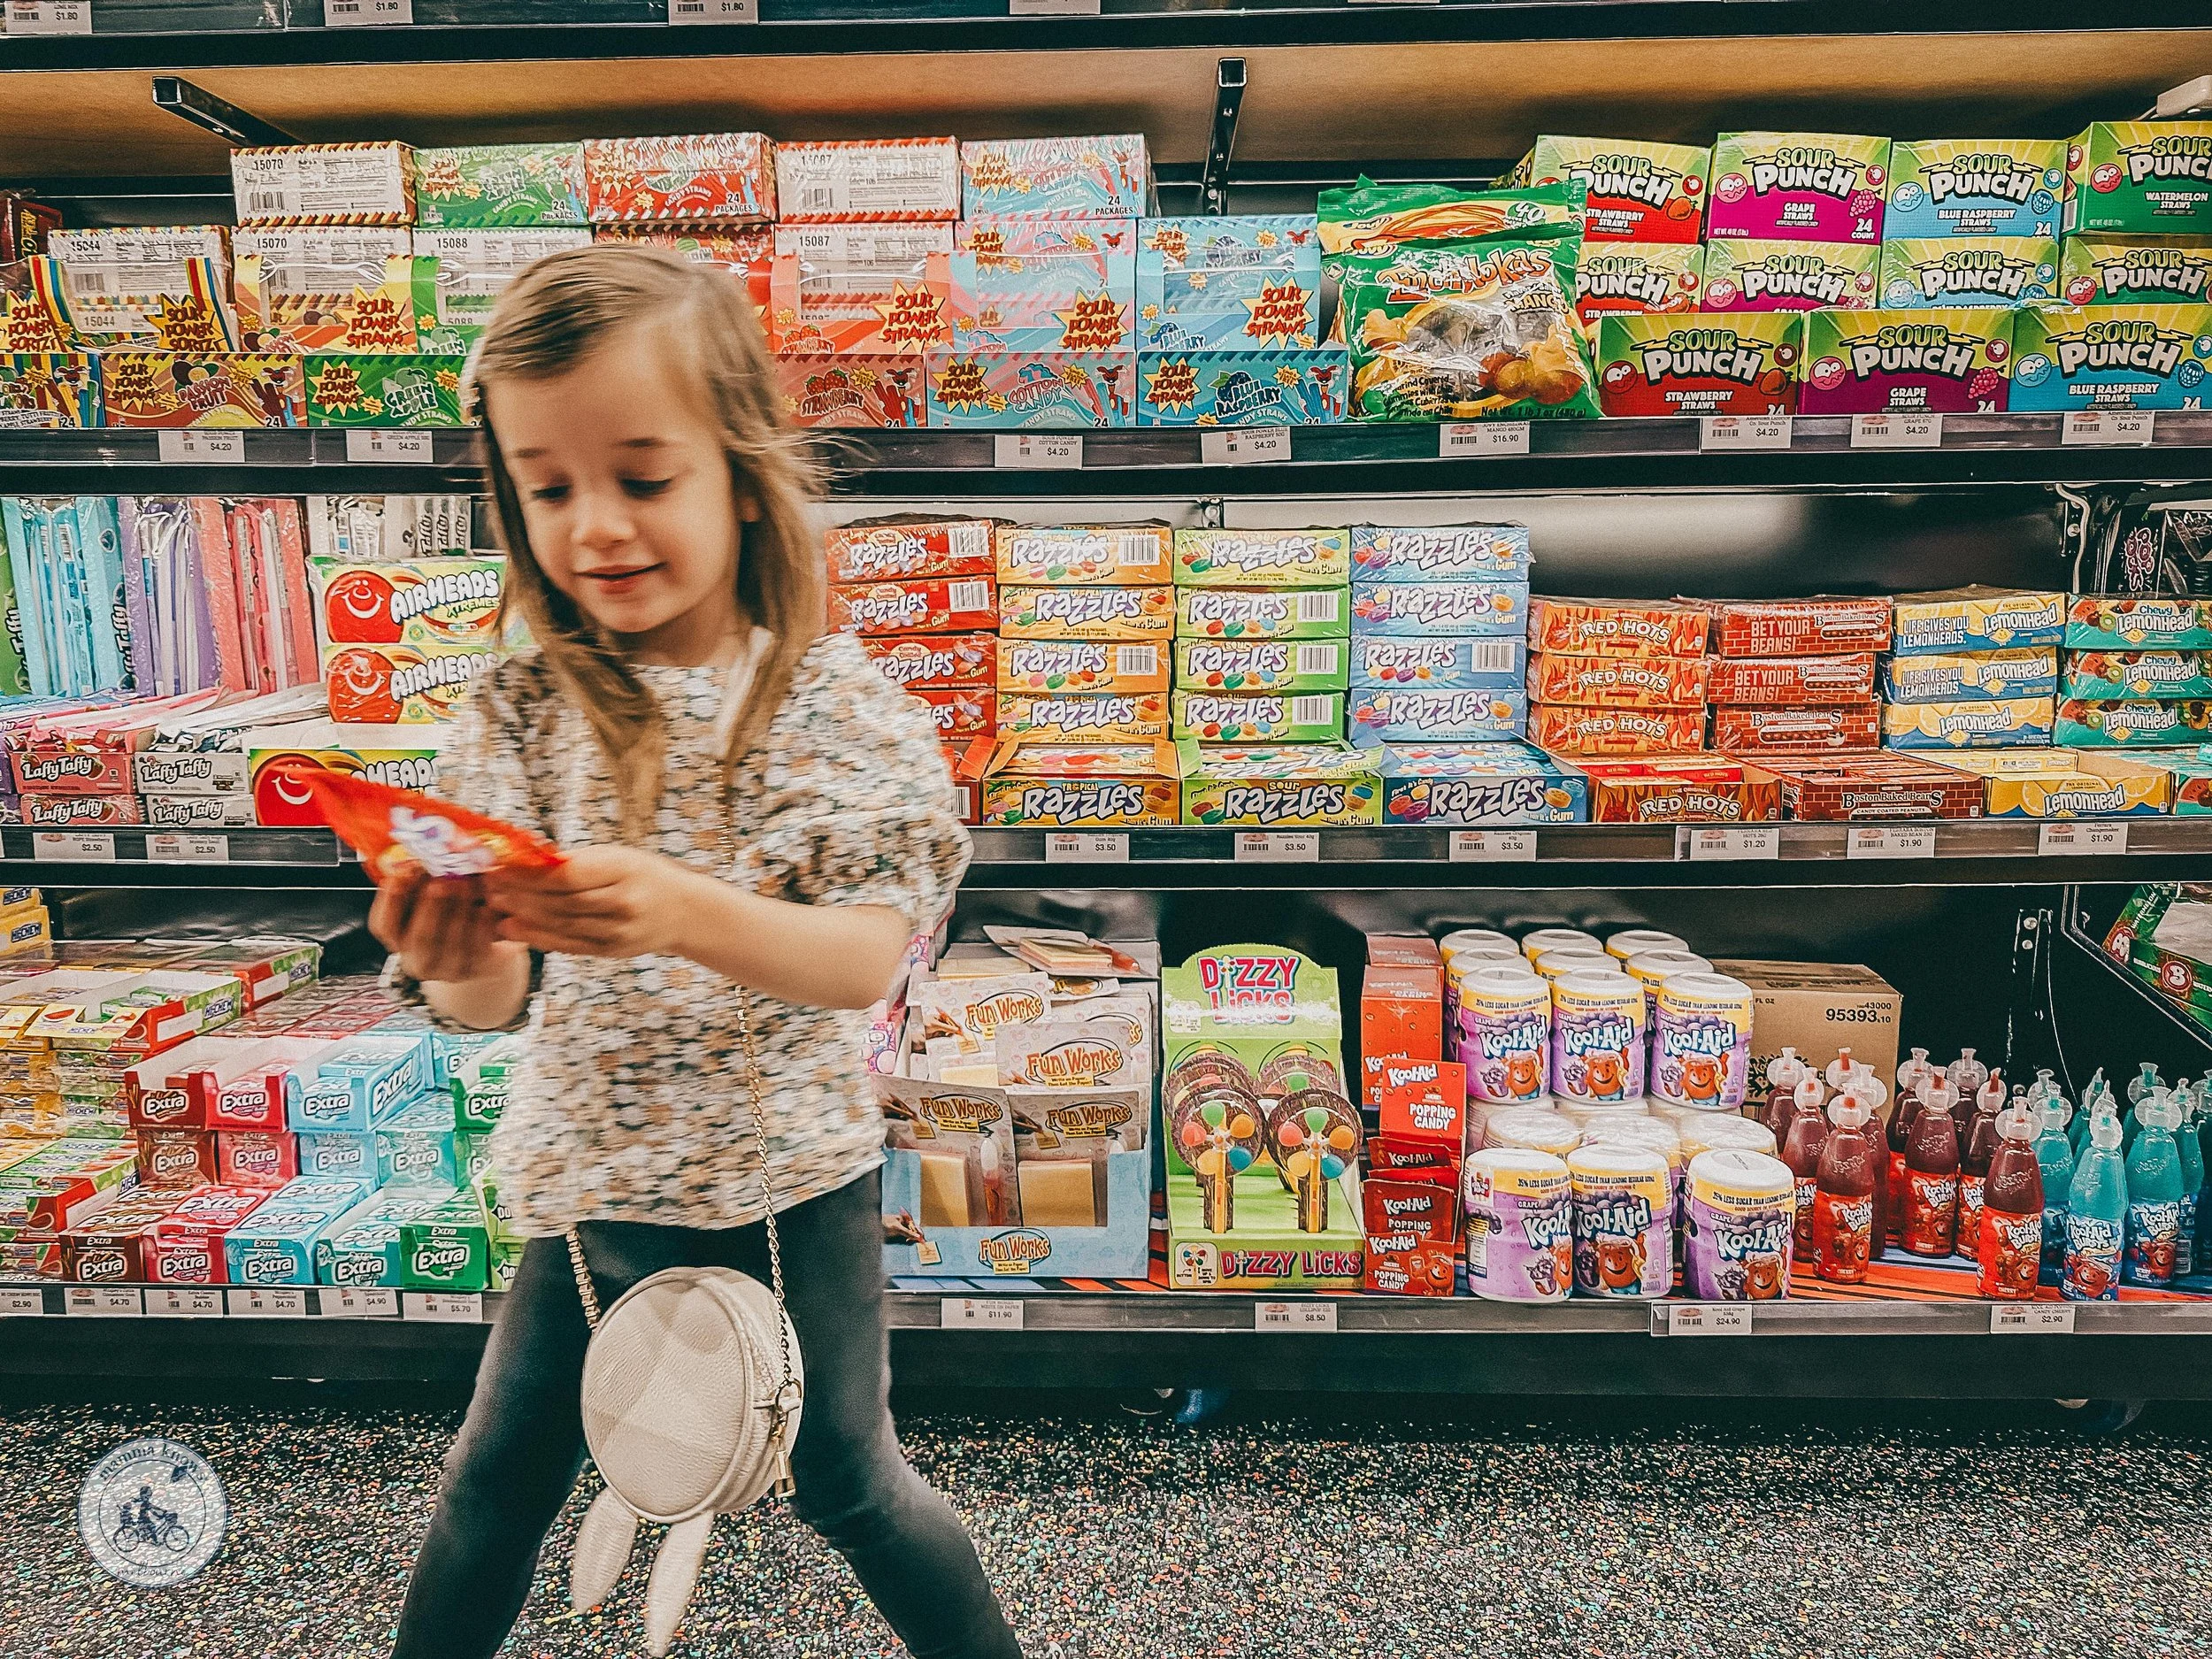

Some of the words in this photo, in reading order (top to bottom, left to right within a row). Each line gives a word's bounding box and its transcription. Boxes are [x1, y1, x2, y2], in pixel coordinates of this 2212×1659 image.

[376, 2, 398, 11] $1.80
[1593, 155, 1651, 177] SOUR
[1776, 148, 1835, 168] SOUR
[1953, 155, 2013, 175] SOUR
[2128, 155, 2212, 183] PUNC
[1569, 169, 1675, 210] PUNCH
[1753, 165, 1857, 201] PUNCH
[1931, 172, 2035, 204] PUNCH
[727, 193, 741, 204] 24
[1107, 196, 1120, 206] 24
[2145, 192, 2208, 202] WATERMELON
[1095, 206, 1133, 215] PACKAGES
[1517, 202, 1545, 221] 40
[1782, 211, 1815, 220] STRAWS
[1784, 203, 1816, 213] GRAPE
[1938, 210, 1962, 219] BLUE
[1855, 219, 1873, 232] 24
[257, 238, 287, 248] 15070
[437, 238, 467, 248] 15088
[799, 236, 830, 247] 15087
[1851, 231, 1876, 240] COUNT
[357, 298, 395, 314] SOUR
[895, 292, 933, 310] SOUR
[1076, 300, 1115, 316] SOUR
[84, 316, 115, 326] 15044
[352, 316, 399, 332] POWER
[888, 311, 938, 326] POWER
[1069, 318, 1119, 332] POWER
[883, 327, 941, 343] STRAWS
[1063, 332, 1121, 350] STRAWS
[1668, 329, 1738, 352] SOUR
[1878, 325, 1948, 349] SOUR
[2085, 321, 2156, 344] SOUR
[1851, 346, 1975, 383] PUNCH
[2057, 341, 2184, 378] PUNCH
[1643, 350, 1764, 387] PUNCH
[179, 377, 232, 401] PASSION
[1010, 378, 1064, 404] COTTON
[1154, 379, 1194, 390] POWER
[1890, 388, 1927, 398] GRAPE
[2069, 385, 2096, 395] BLUE
[2096, 384, 2160, 395] RASPBERRY
[189, 391, 227, 411] FRUIT
[386, 383, 434, 404] GREEN
[1664, 391, 1733, 403] STRAWBERRY
[1889, 396, 1926, 406] STRAWS
[2095, 394, 2131, 403] STRAWS
[389, 396, 437, 419] APPLE
[802, 390, 864, 416] STRAWBERRY
[1215, 388, 1282, 418] RASPBERRY
[1681, 401, 1717, 411] STRAWS
[1493, 434, 1518, 443] $16.90
[1755, 427, 1779, 437] $4.20
[1905, 426, 1929, 434] $4.20
[1495, 560, 1517, 571] Gum
[390, 569, 500, 625] AIRHEADS
[446, 596, 501, 618] XTREMES
[2139, 604, 2173, 616] Chewy
[1578, 620, 1617, 641] RED
[1622, 619, 1671, 644] HOTS
[1750, 621, 1774, 636] BET
[1775, 619, 1810, 636] YOUR
[1903, 619, 1924, 634] LIFE
[1924, 618, 1949, 632] GIVES
[1949, 616, 1970, 630] YOU
[1750, 637, 1796, 653] BEANS!
[22, 758, 60, 780] Laffy
[58, 755, 93, 775] Taffy
[142, 764, 179, 783] Laffy
[177, 758, 212, 778] Taffy
[1639, 795, 1683, 818] RED
[1688, 795, 1742, 818] HOTS
[1841, 792, 1873, 809] Boston
[1874, 791, 1906, 802] Baked
[1550, 809, 1575, 822] Gum
[1743, 840, 1765, 849] $1.20
[1900, 839, 1922, 848] $1.90
[965, 1003, 997, 1026] Fun
[998, 996, 1043, 1024] Works
[1825, 1009, 1877, 1023] 95393
[1479, 1015, 1547, 1058] Kool-Aid
[1561, 1023, 1633, 1056] Kool-Aid
[1661, 1022, 1736, 1055] Kool-Aid
[1026, 1052, 1064, 1077] Fun
[1064, 1046, 1122, 1074] Works
[1387, 1064, 1437, 1087] Kool-Aid
[145, 1096, 186, 1113] Extra
[221, 1092, 265, 1111] Extra
[304, 1094, 350, 1115] Extra
[1409, 1103, 1456, 1119] POPPING
[1414, 1116, 1449, 1131] CANDY
[1382, 1195, 1432, 1216] Kool-Aid
[1369, 1235, 1417, 1255] Kool-Aid
[82, 1259, 124, 1278] Extra
[162, 1255, 206, 1275] Extra
[248, 1256, 293, 1278] Extra
[1374, 1270, 1409, 1283] POPPING
[1378, 1279, 1405, 1291] CANDY
[2041, 1315, 2063, 1324] $2.90
